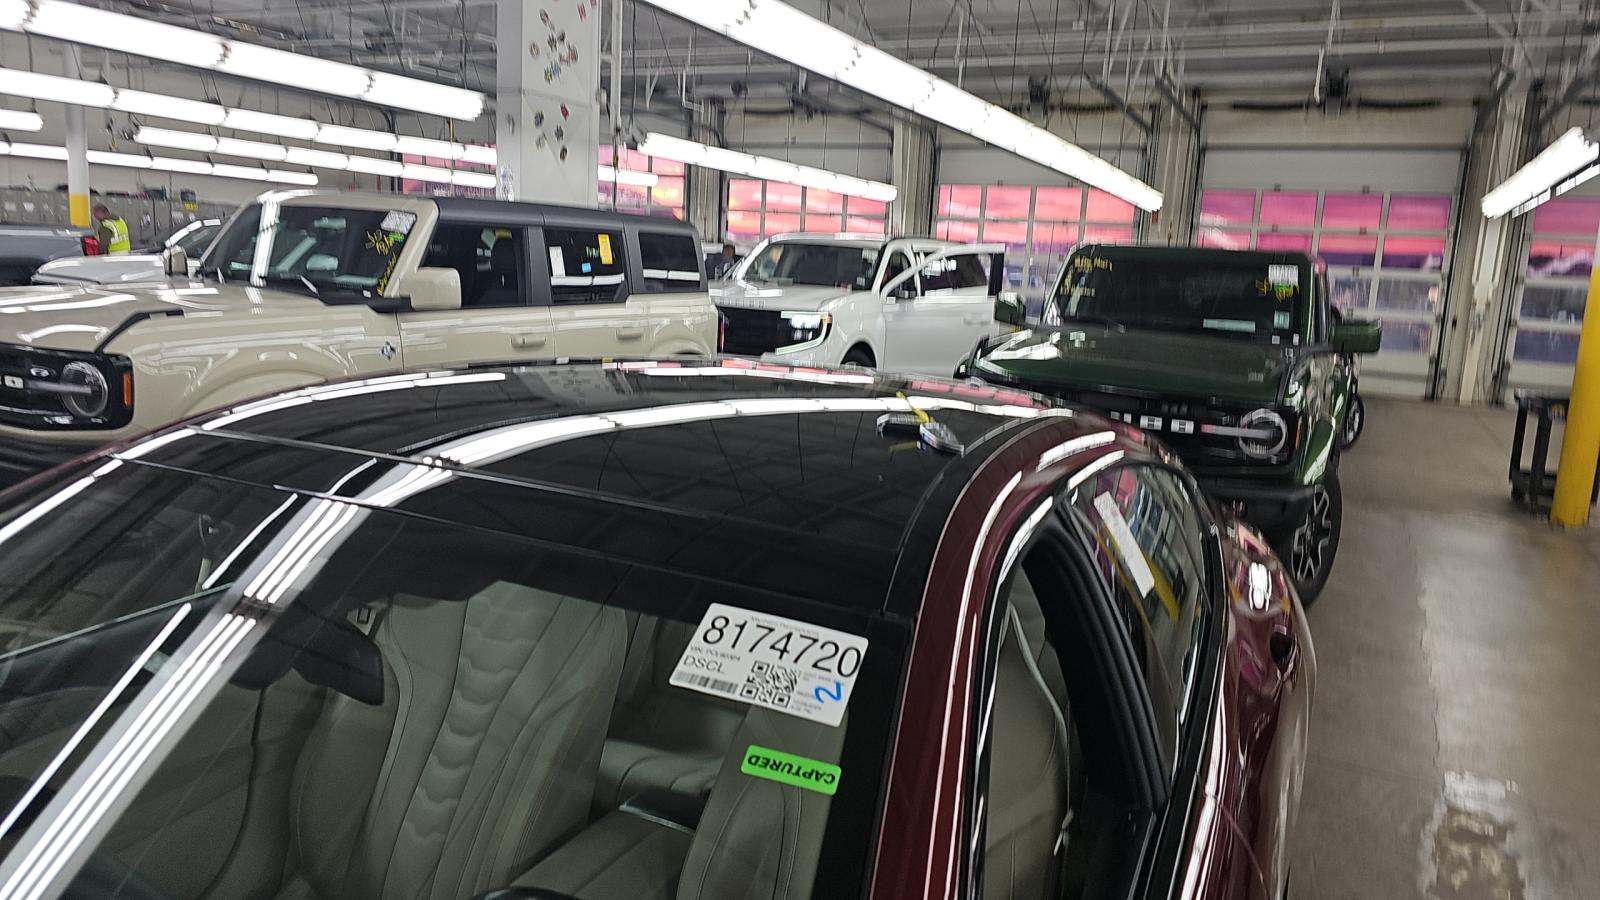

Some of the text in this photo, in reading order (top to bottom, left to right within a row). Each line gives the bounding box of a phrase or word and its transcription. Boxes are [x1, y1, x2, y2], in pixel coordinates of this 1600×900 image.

[703, 616, 861, 678] 8174720
[683, 655, 725, 674] DSCL
[747, 754, 836, 785] CAPTURED
